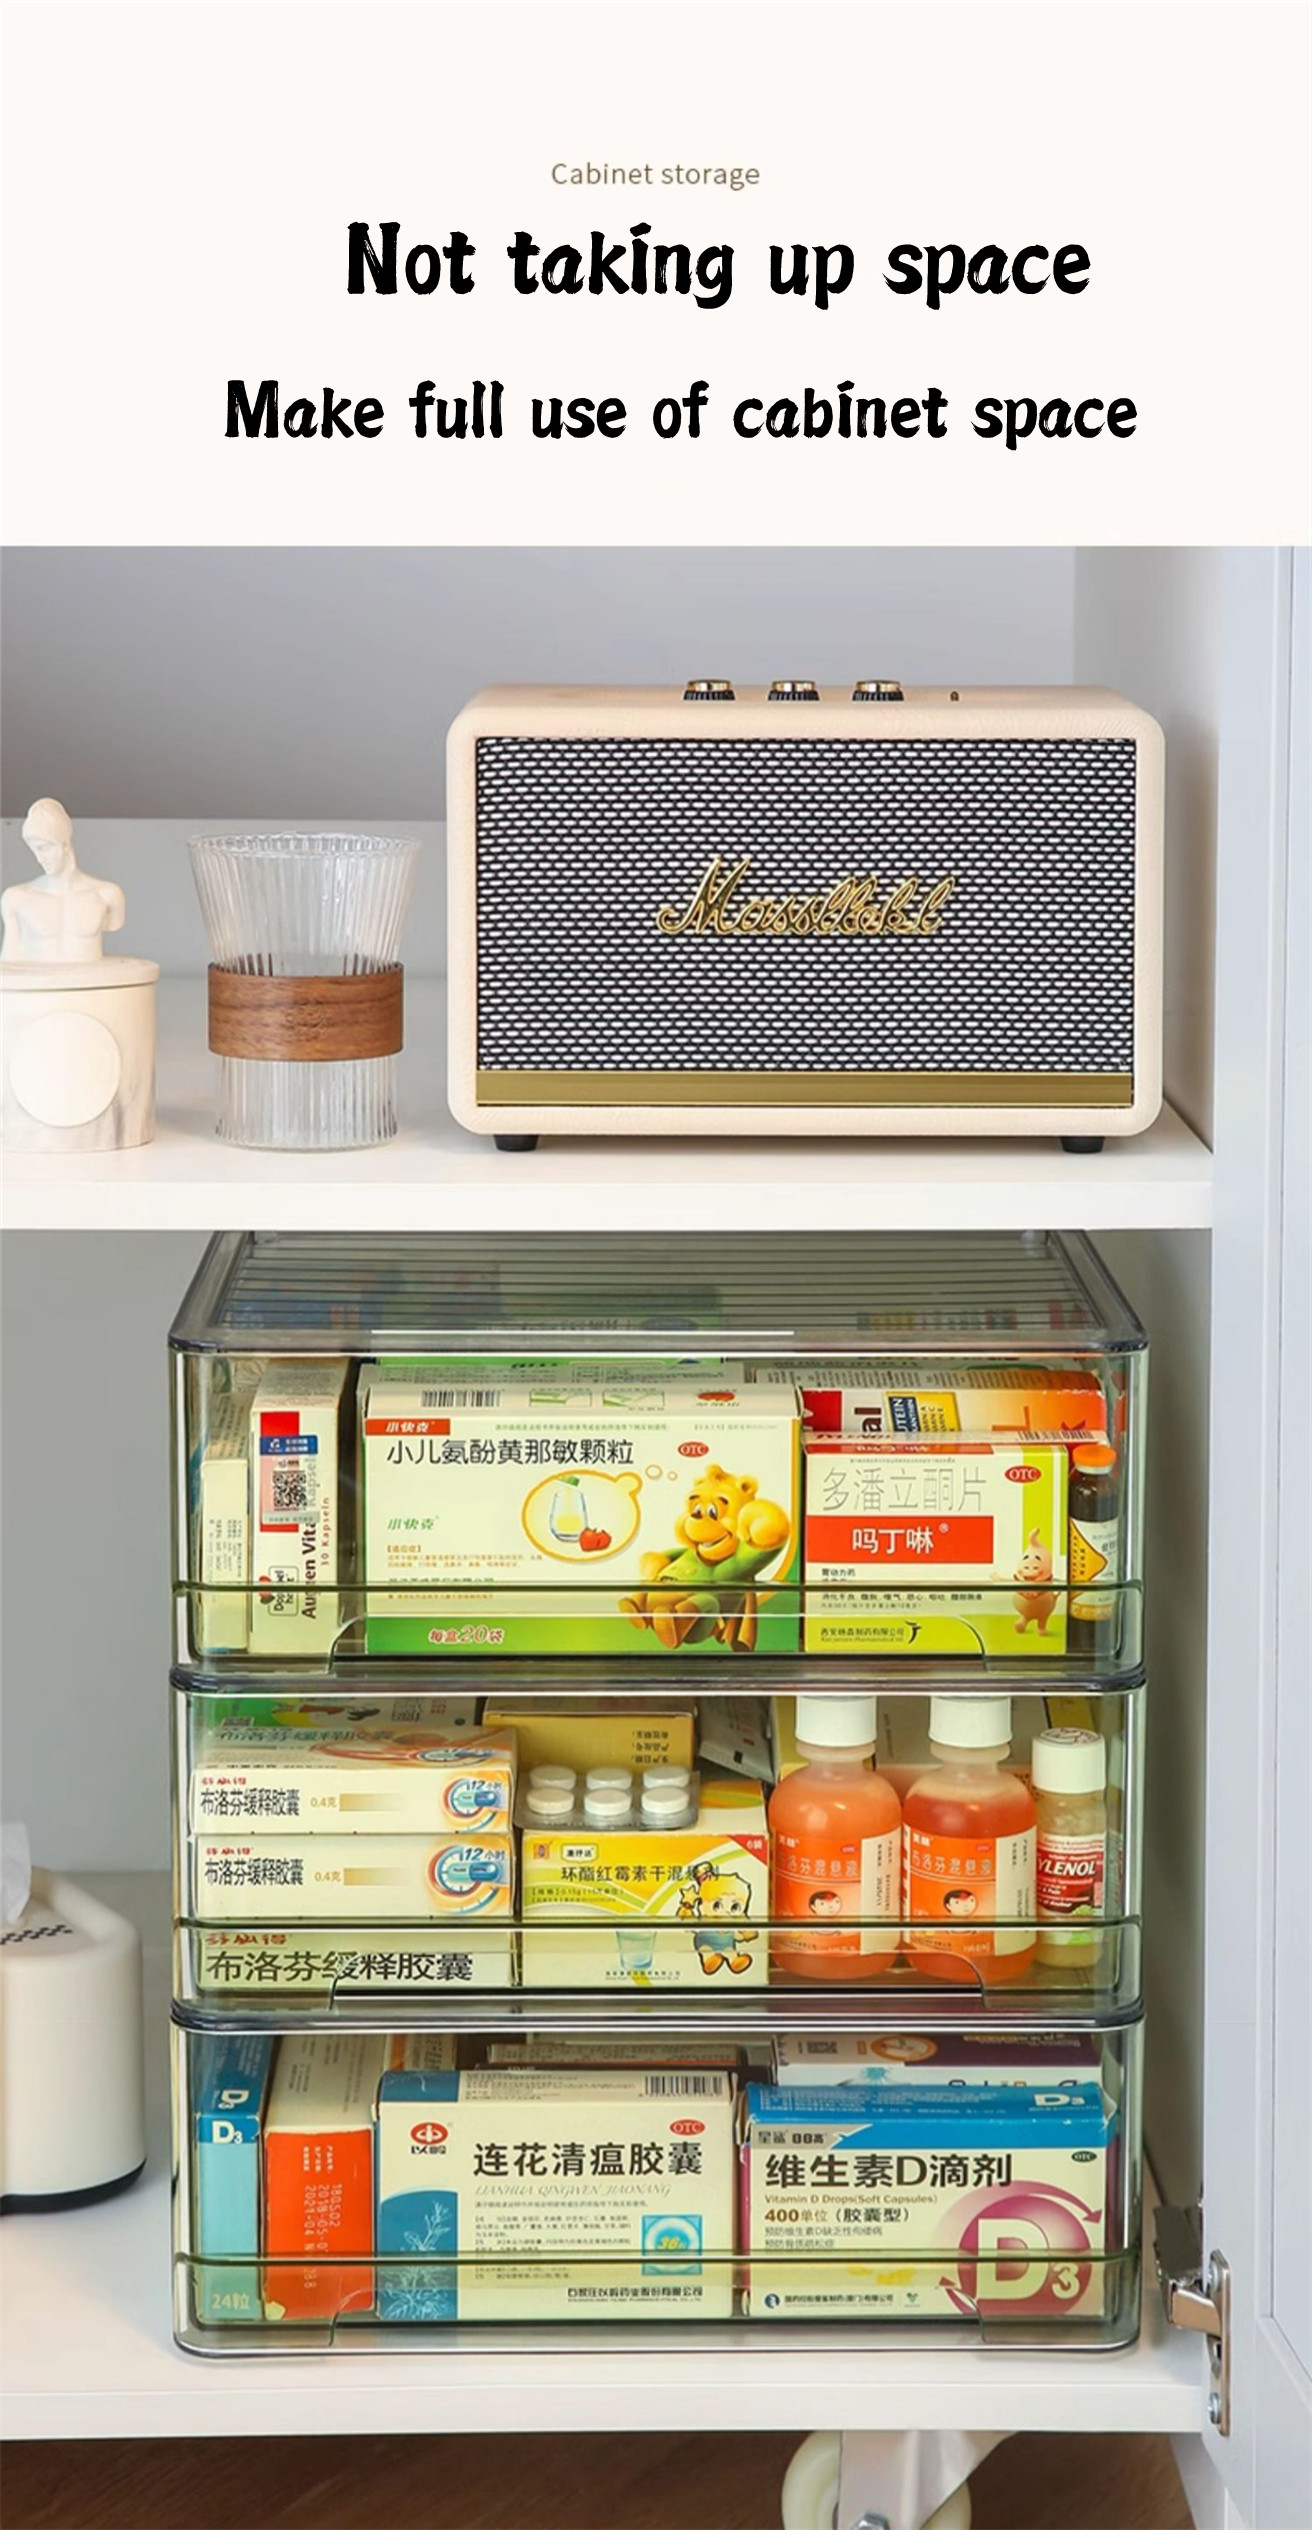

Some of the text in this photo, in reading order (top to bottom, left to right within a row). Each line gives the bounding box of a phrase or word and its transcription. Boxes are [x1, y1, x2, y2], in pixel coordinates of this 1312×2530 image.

[894, 1398, 908, 1432] UTEIN
[387, 1439, 634, 1465] 小儿氨酚黄那敏颗粒
[681, 1443, 707, 1456] OTC
[1008, 1467, 1039, 1481] OTC
[822, 1467, 987, 1512] 多潘立酮片
[321, 1497, 330, 1547] Kapseln
[852, 1526, 934, 1554] 吗丁啉
[429, 1626, 505, 1644] 每盒20袋
[200, 1787, 337, 1816] 布洛芬缓释胶囊 0.4克
[204, 1857, 341, 1886] 布洛芬缓释胶囊 0.4克
[1037, 1857, 1096, 1877] YLENOL
[206, 1951, 473, 1981] 布洛芬缓释胶囊
[212, 2120, 243, 2145] D3
[673, 2120, 703, 2134] OTC
[473, 2142, 703, 2177] 连花清瘟胶囊
[765, 2153, 1012, 2188] 维生素D滴剂
[765, 2194, 808, 2204] Vitamin
[811, 2194, 820, 2204] D
[883, 2194, 938, 2206] Capsules)
[317, 2183, 330, 2253] 2018-05-0
[765, 2208, 828, 2222] 400单位
[976, 2216, 1081, 2301] D3
[211, 2293, 250, 2309] 24粒
